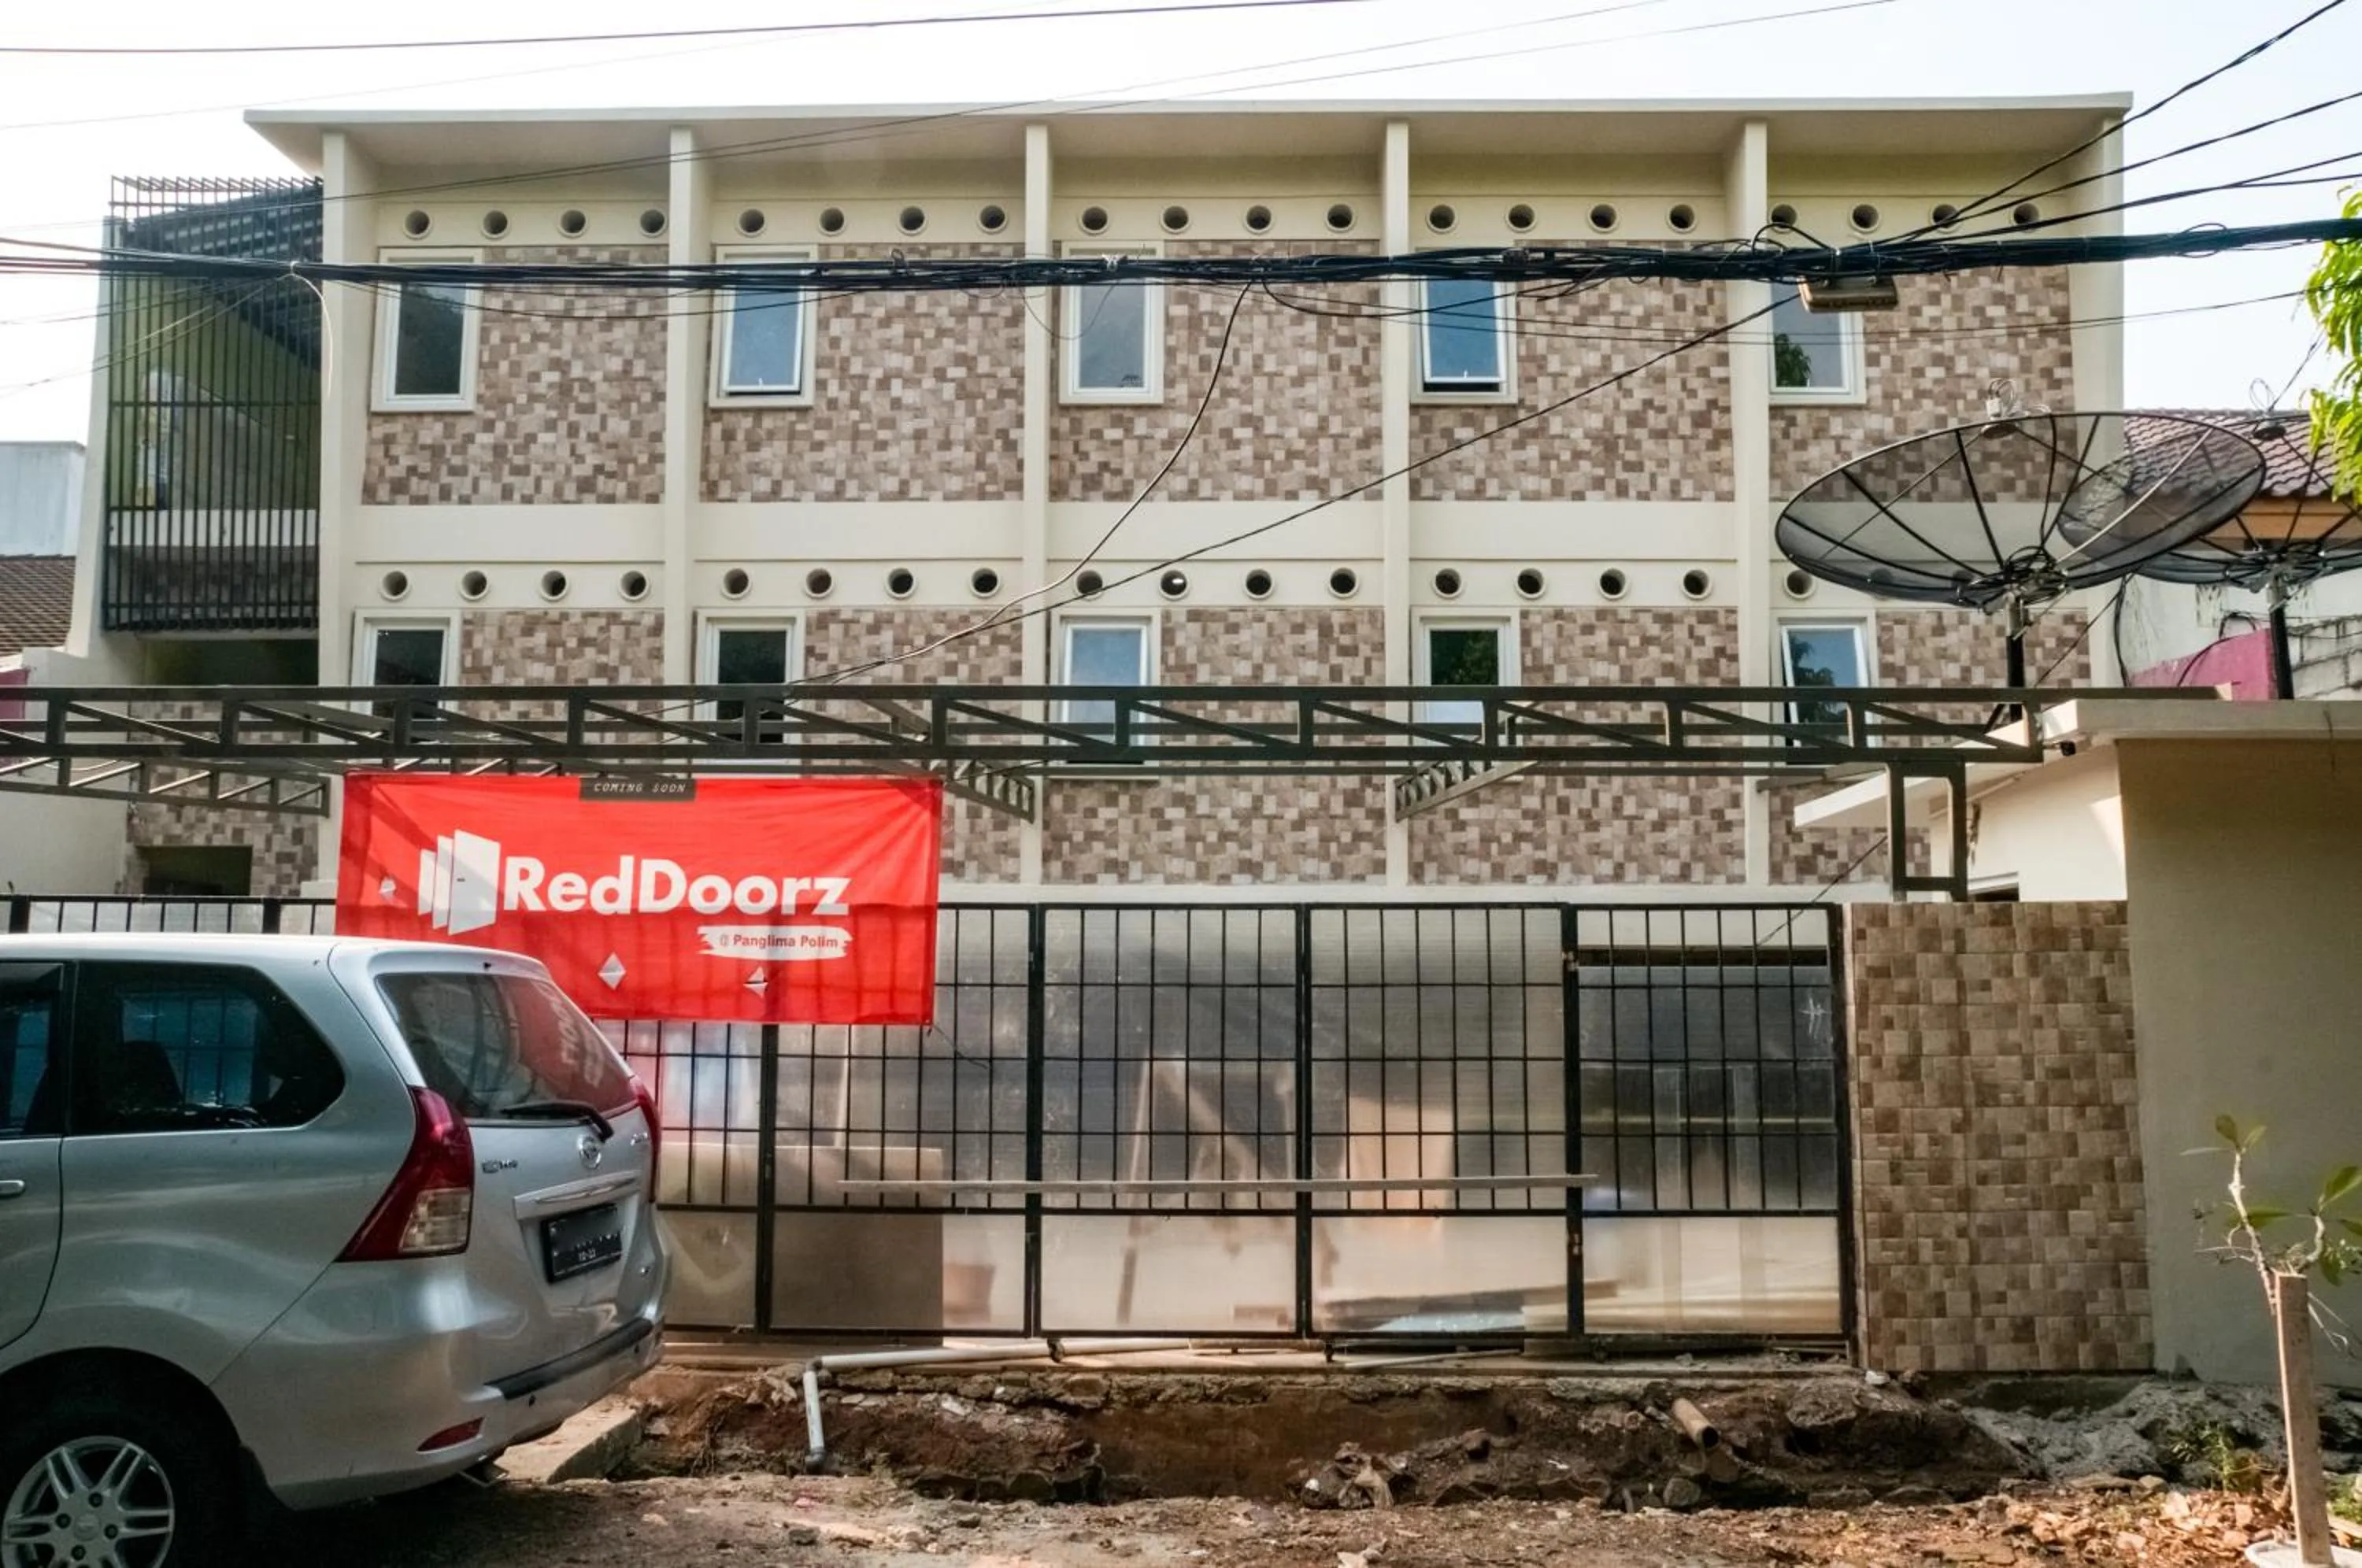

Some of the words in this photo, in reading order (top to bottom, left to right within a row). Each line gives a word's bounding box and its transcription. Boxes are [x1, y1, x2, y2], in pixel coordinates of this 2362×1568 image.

[593, 782, 643, 793] COMING
[652, 782, 687, 793] SOON
[502, 855, 850, 916] RedDoorz
[733, 934, 796, 949] Panglima
[801, 934, 839, 948] Polim
